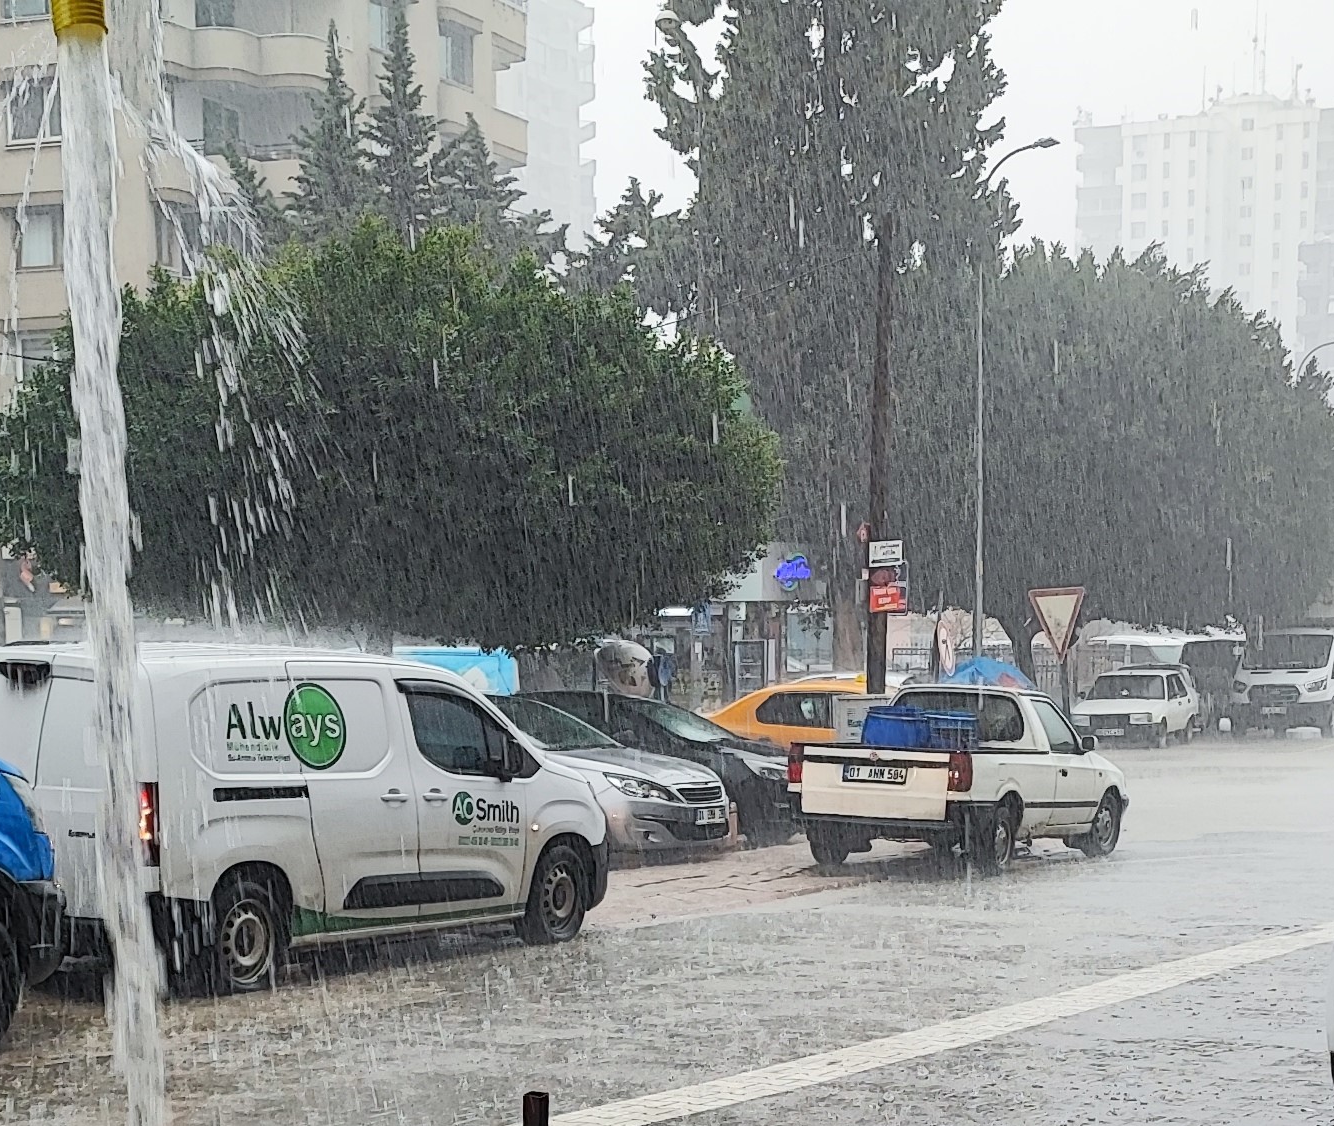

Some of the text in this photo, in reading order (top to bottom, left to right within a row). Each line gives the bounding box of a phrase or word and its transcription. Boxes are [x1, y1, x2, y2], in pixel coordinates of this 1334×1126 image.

[226, 701, 341, 747] Always
[849, 767, 861, 778] 01
[476, 798, 520, 823] Smith
